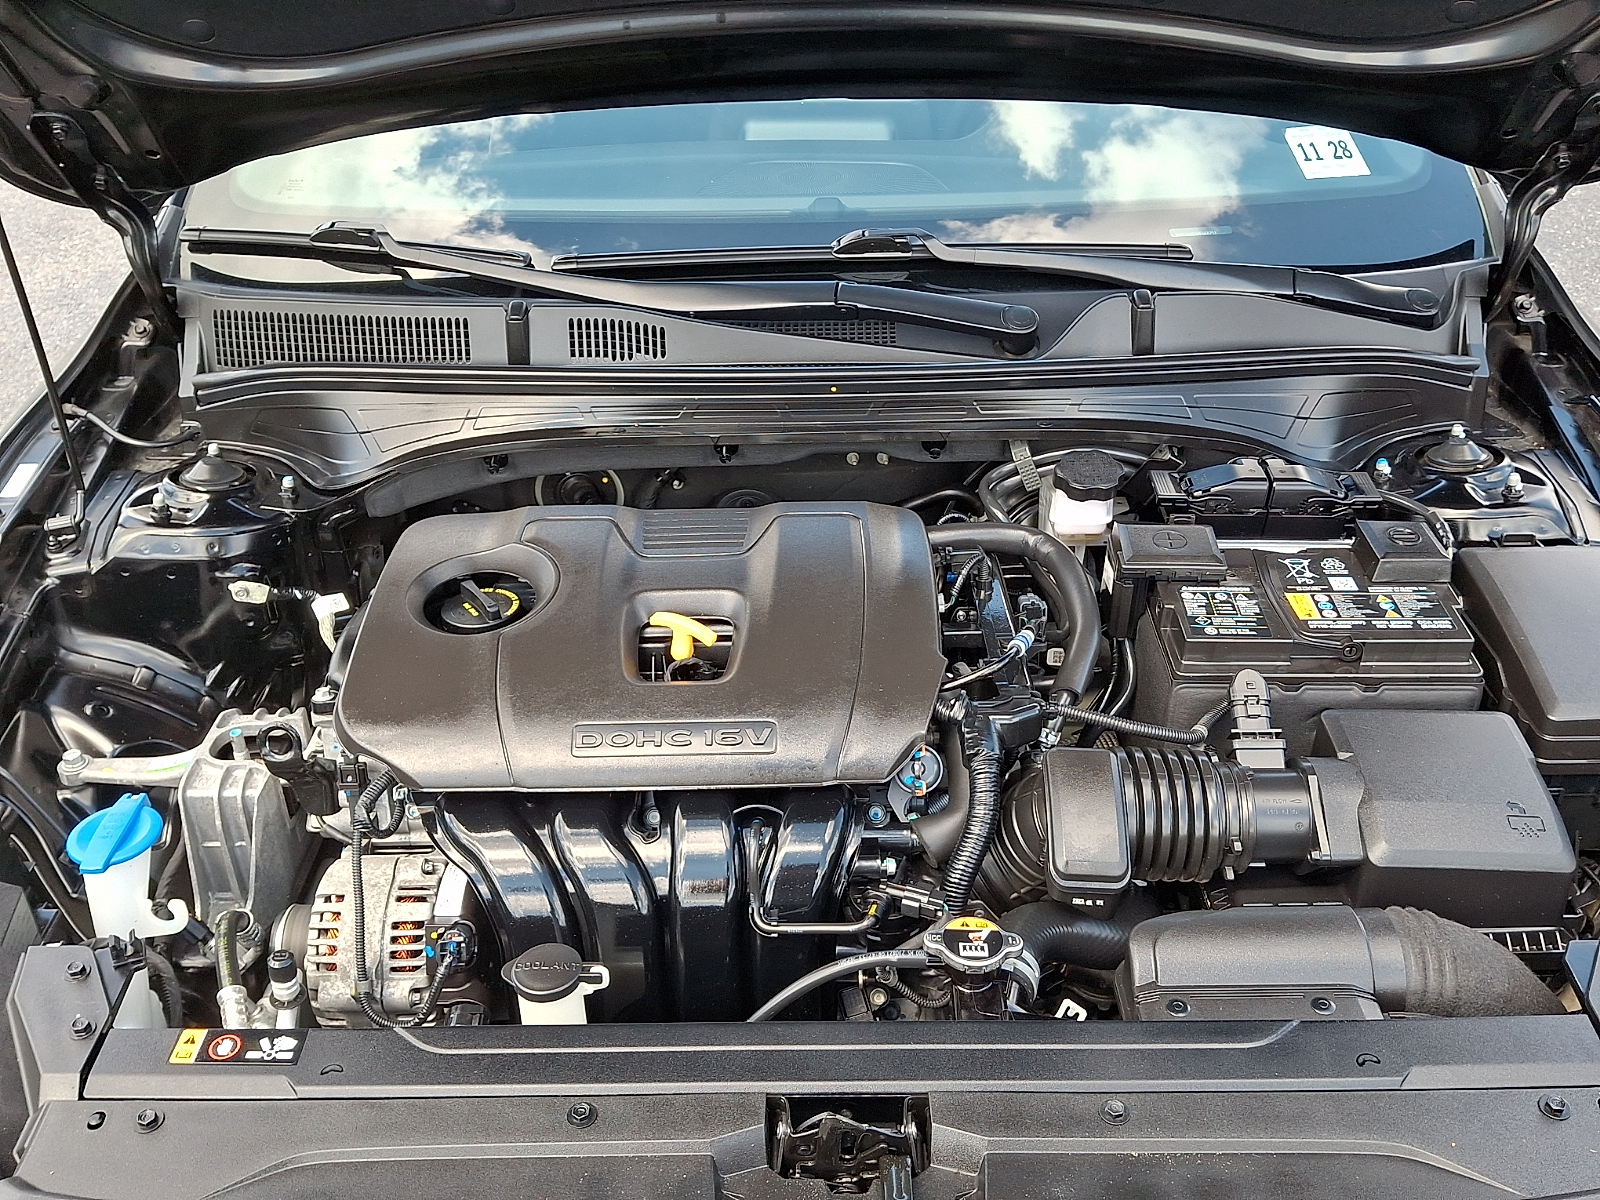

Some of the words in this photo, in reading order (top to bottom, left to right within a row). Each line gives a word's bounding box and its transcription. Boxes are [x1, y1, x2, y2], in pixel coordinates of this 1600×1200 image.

[1297, 142, 1324, 161] 11
[1327, 140, 1353, 159] 28
[575, 729, 693, 748] DOHC
[704, 727, 774, 746] 16V
[926, 933, 942, 941] HCC
[514, 960, 581, 972] COOLANT
